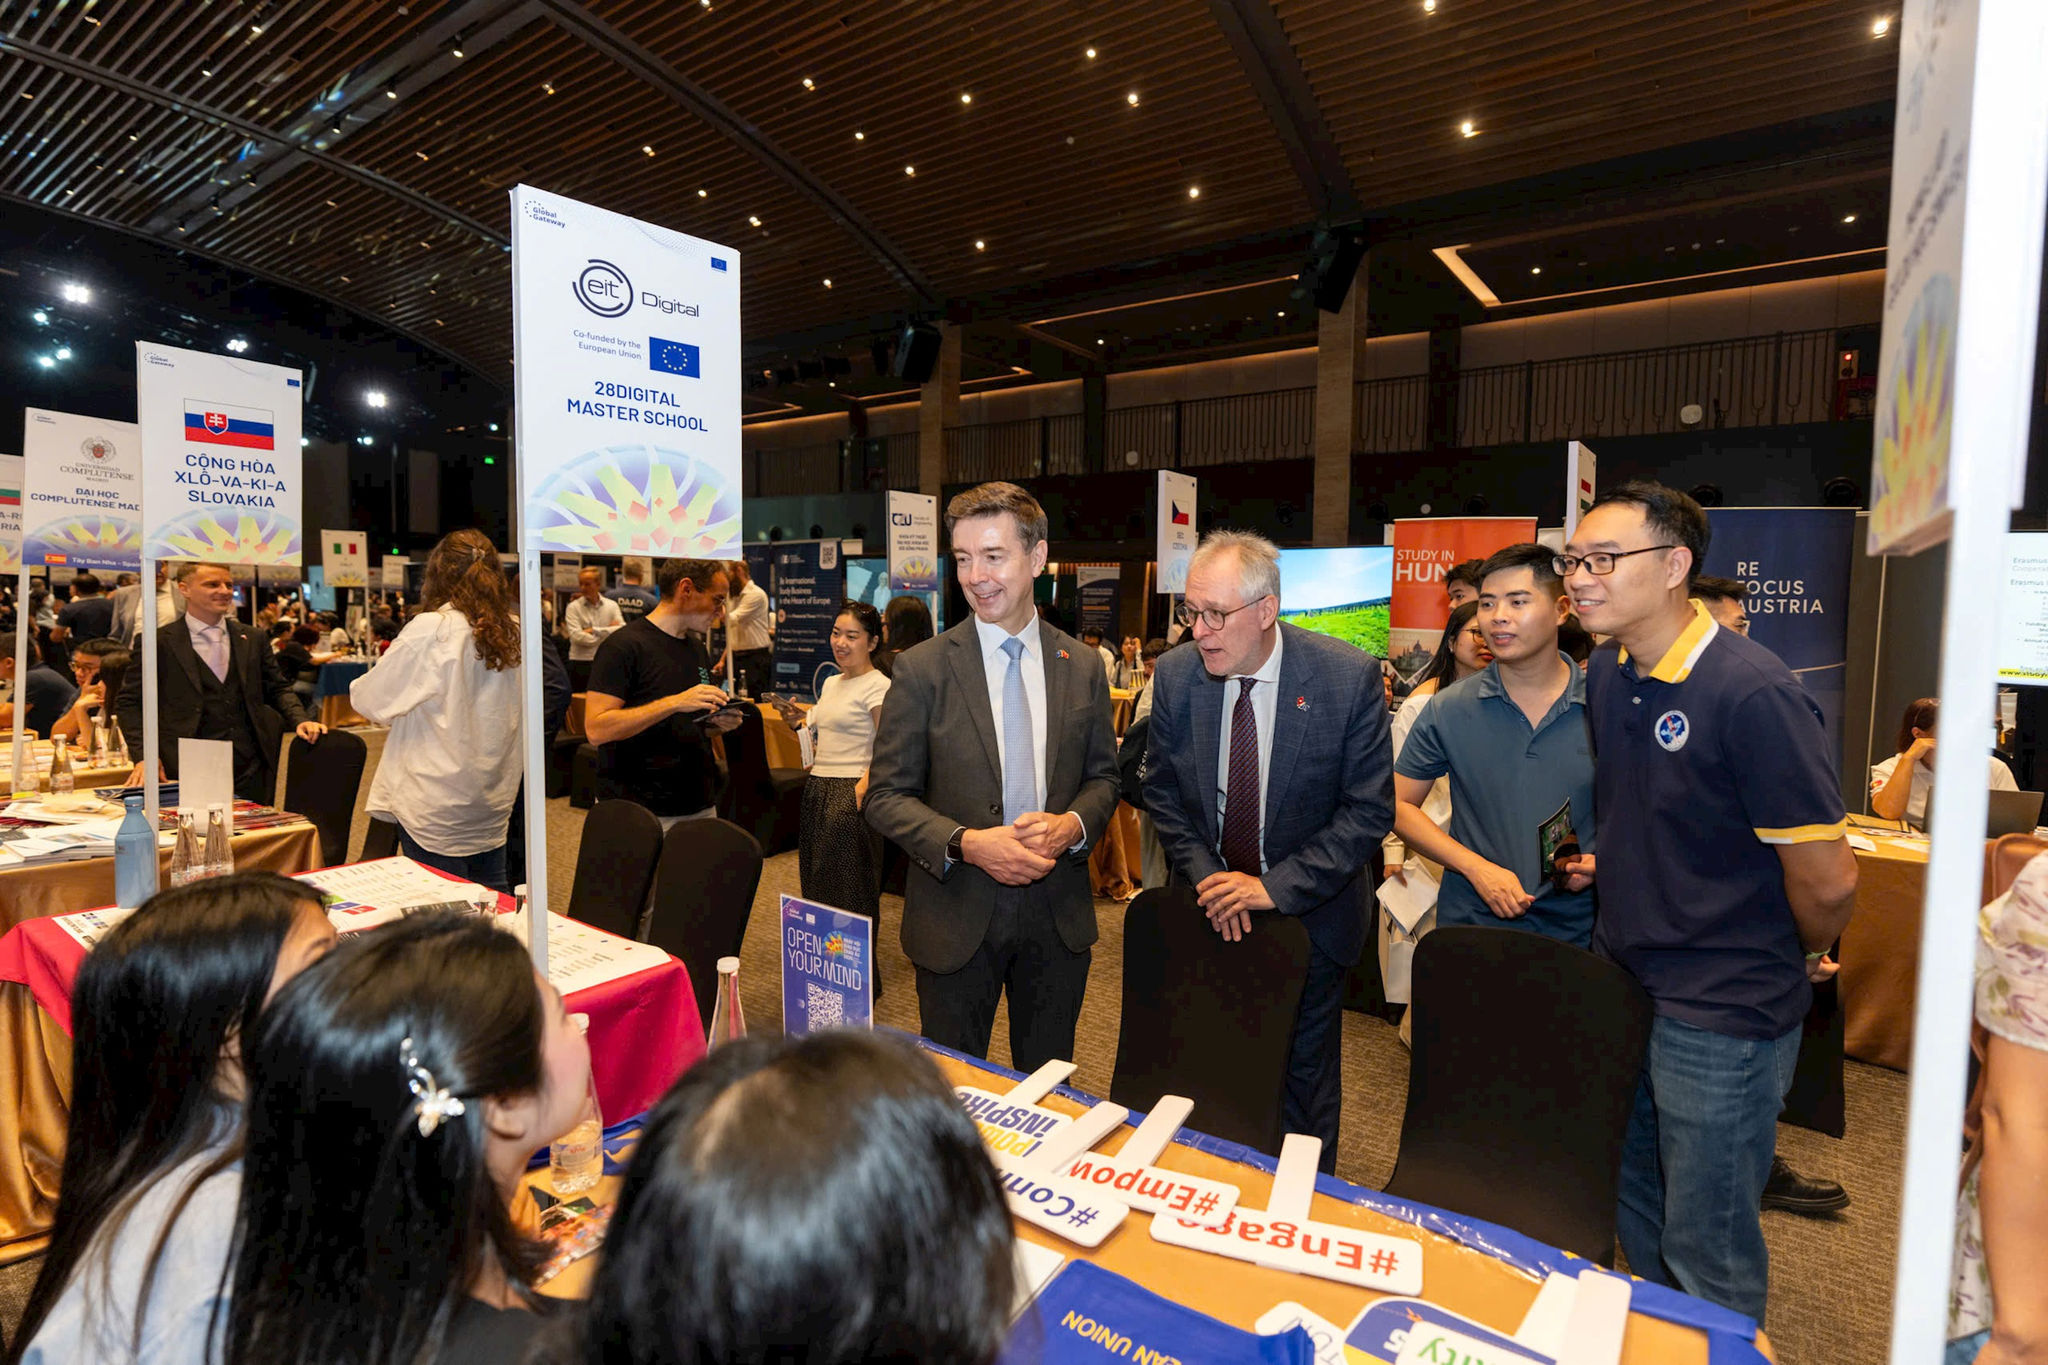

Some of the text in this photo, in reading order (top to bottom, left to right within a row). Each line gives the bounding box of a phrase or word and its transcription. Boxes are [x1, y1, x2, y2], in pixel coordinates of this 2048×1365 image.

[533, 206, 558, 219] Global
[533, 213, 566, 228] Gateway
[587, 279, 620, 299] eit
[642, 292, 699, 317] Digital
[573, 329, 641, 349] Co-funded by the
[578, 341, 642, 360] European Union
[594, 381, 681, 408] 28DIGITAL
[567, 398, 709, 432] MASTER SCHOOL
[60, 465, 135, 481] COMPLUTENSE
[185, 453, 276, 476] CỘNG HÒA
[175, 470, 287, 493] XLÔ-VA-KI-A
[30, 493, 116, 509] COMPLUTENSE
[188, 490, 276, 509] SLOVAKIA
[1397, 549, 1455, 561] STUDY IN
[1737, 562, 1759, 576] RE
[1737, 580, 1804, 595] OCUS
[788, 927, 822, 956] OPEN
[788, 948, 822, 978] YOUR
[823, 960, 862, 991] MIND
[1061, 1310, 1133, 1356] UNION
